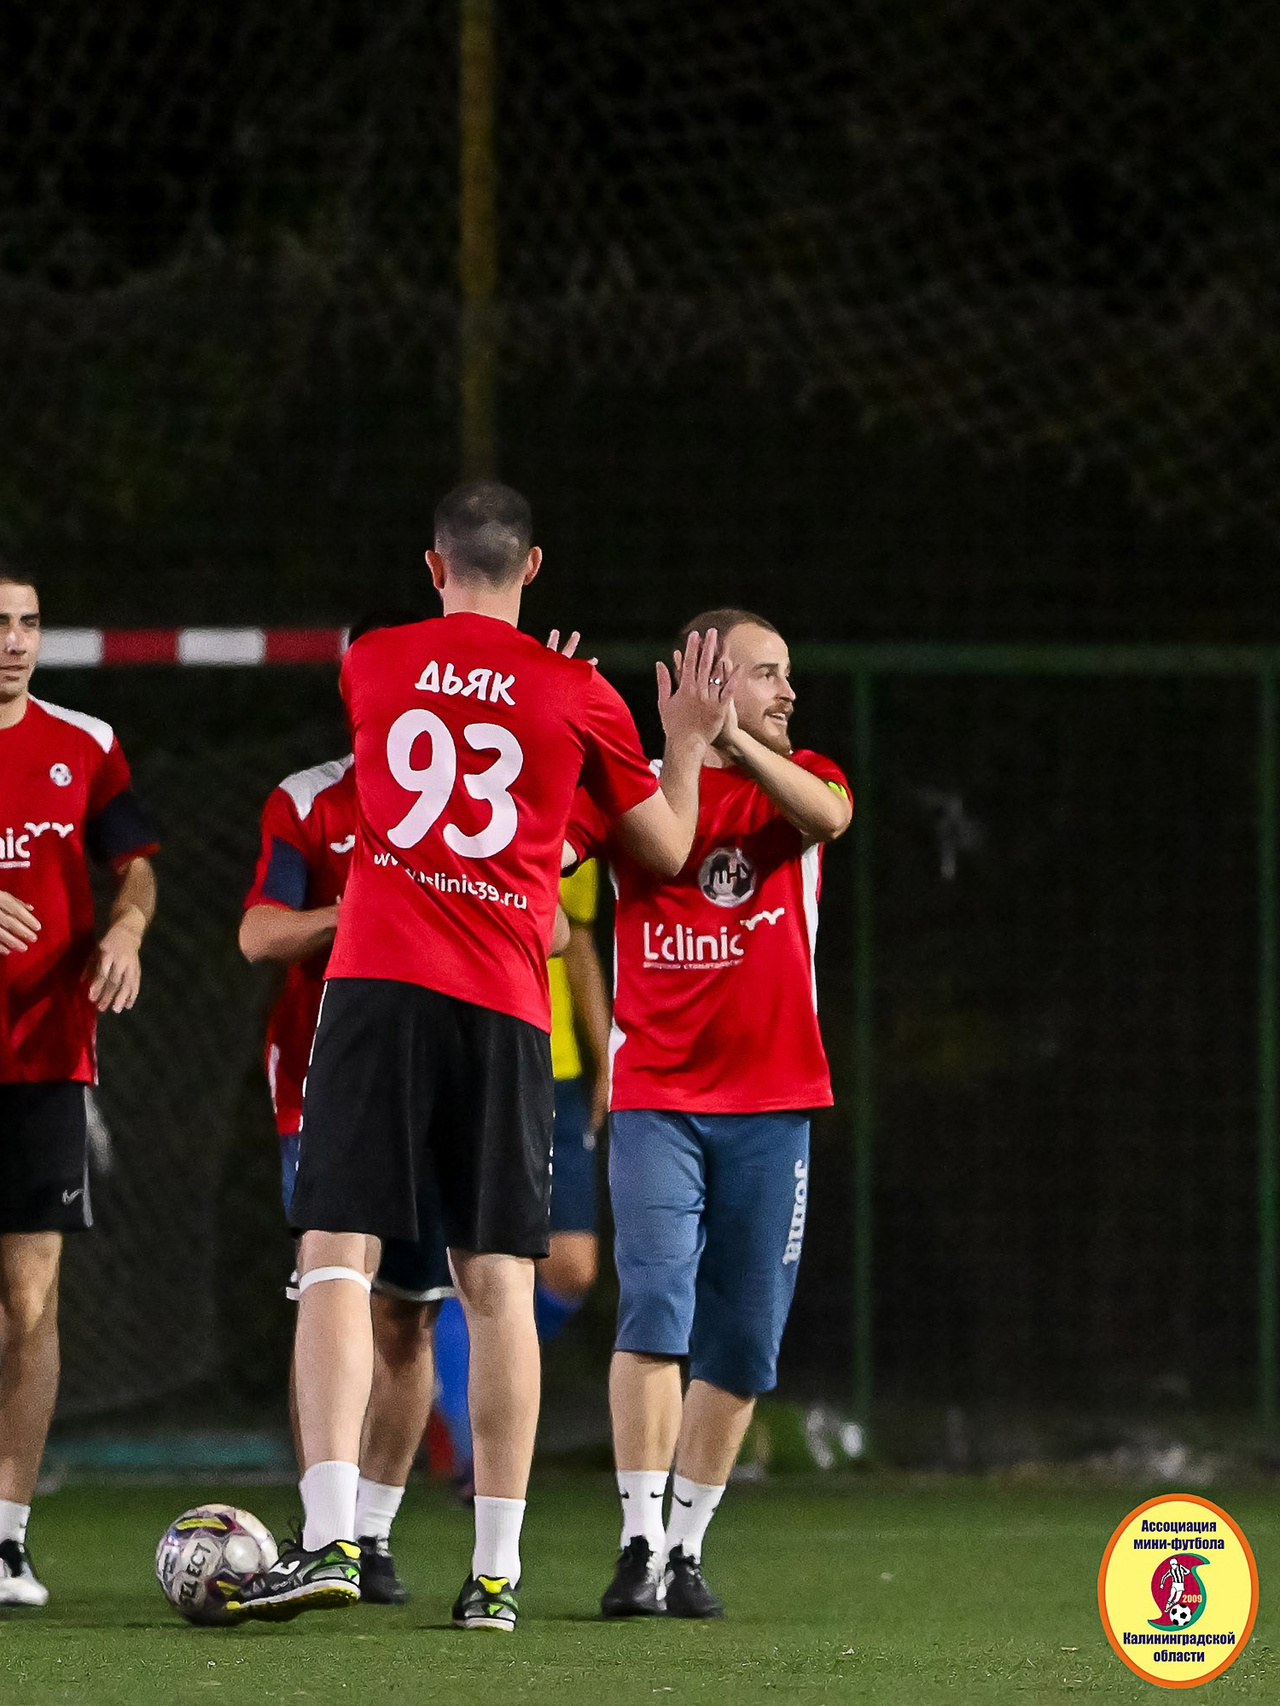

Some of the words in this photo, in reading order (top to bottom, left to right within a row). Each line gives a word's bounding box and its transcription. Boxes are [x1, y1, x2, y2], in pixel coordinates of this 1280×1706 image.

[415, 661, 515, 706] ДЬЯК
[387, 709, 523, 858] 93
[643, 921, 745, 961] L'clinic
